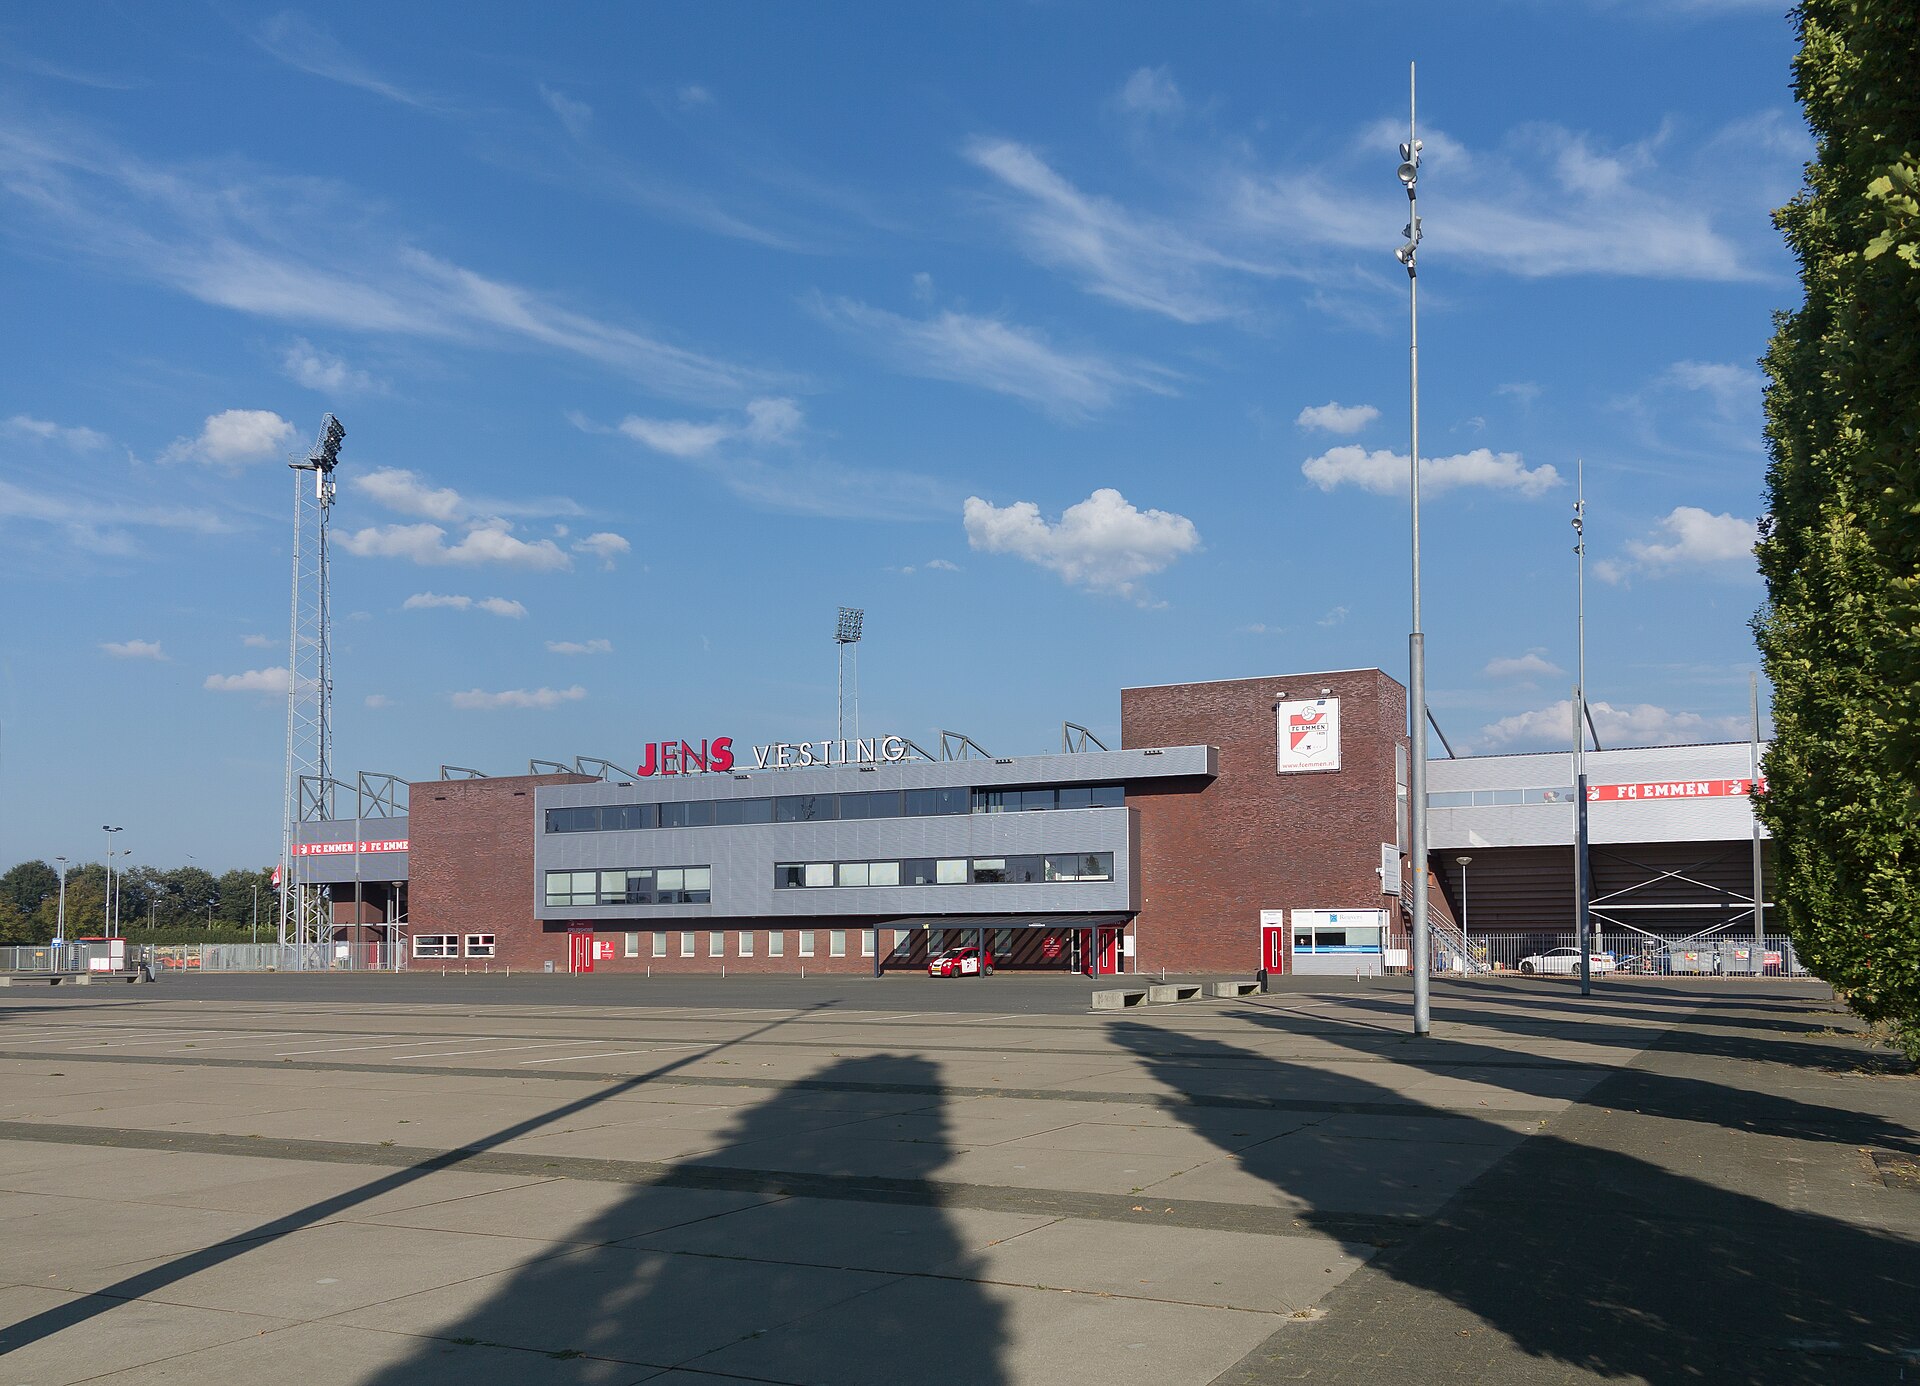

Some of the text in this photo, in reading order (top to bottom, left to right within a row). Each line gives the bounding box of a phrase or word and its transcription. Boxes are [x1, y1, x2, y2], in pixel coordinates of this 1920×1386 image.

[637, 735, 907, 777] JENS VESTING
[1617, 783, 1709, 798] FC EMMEN
[311, 844, 353, 853] FC EMMEN
[371, 841, 408, 851] FC EMME
